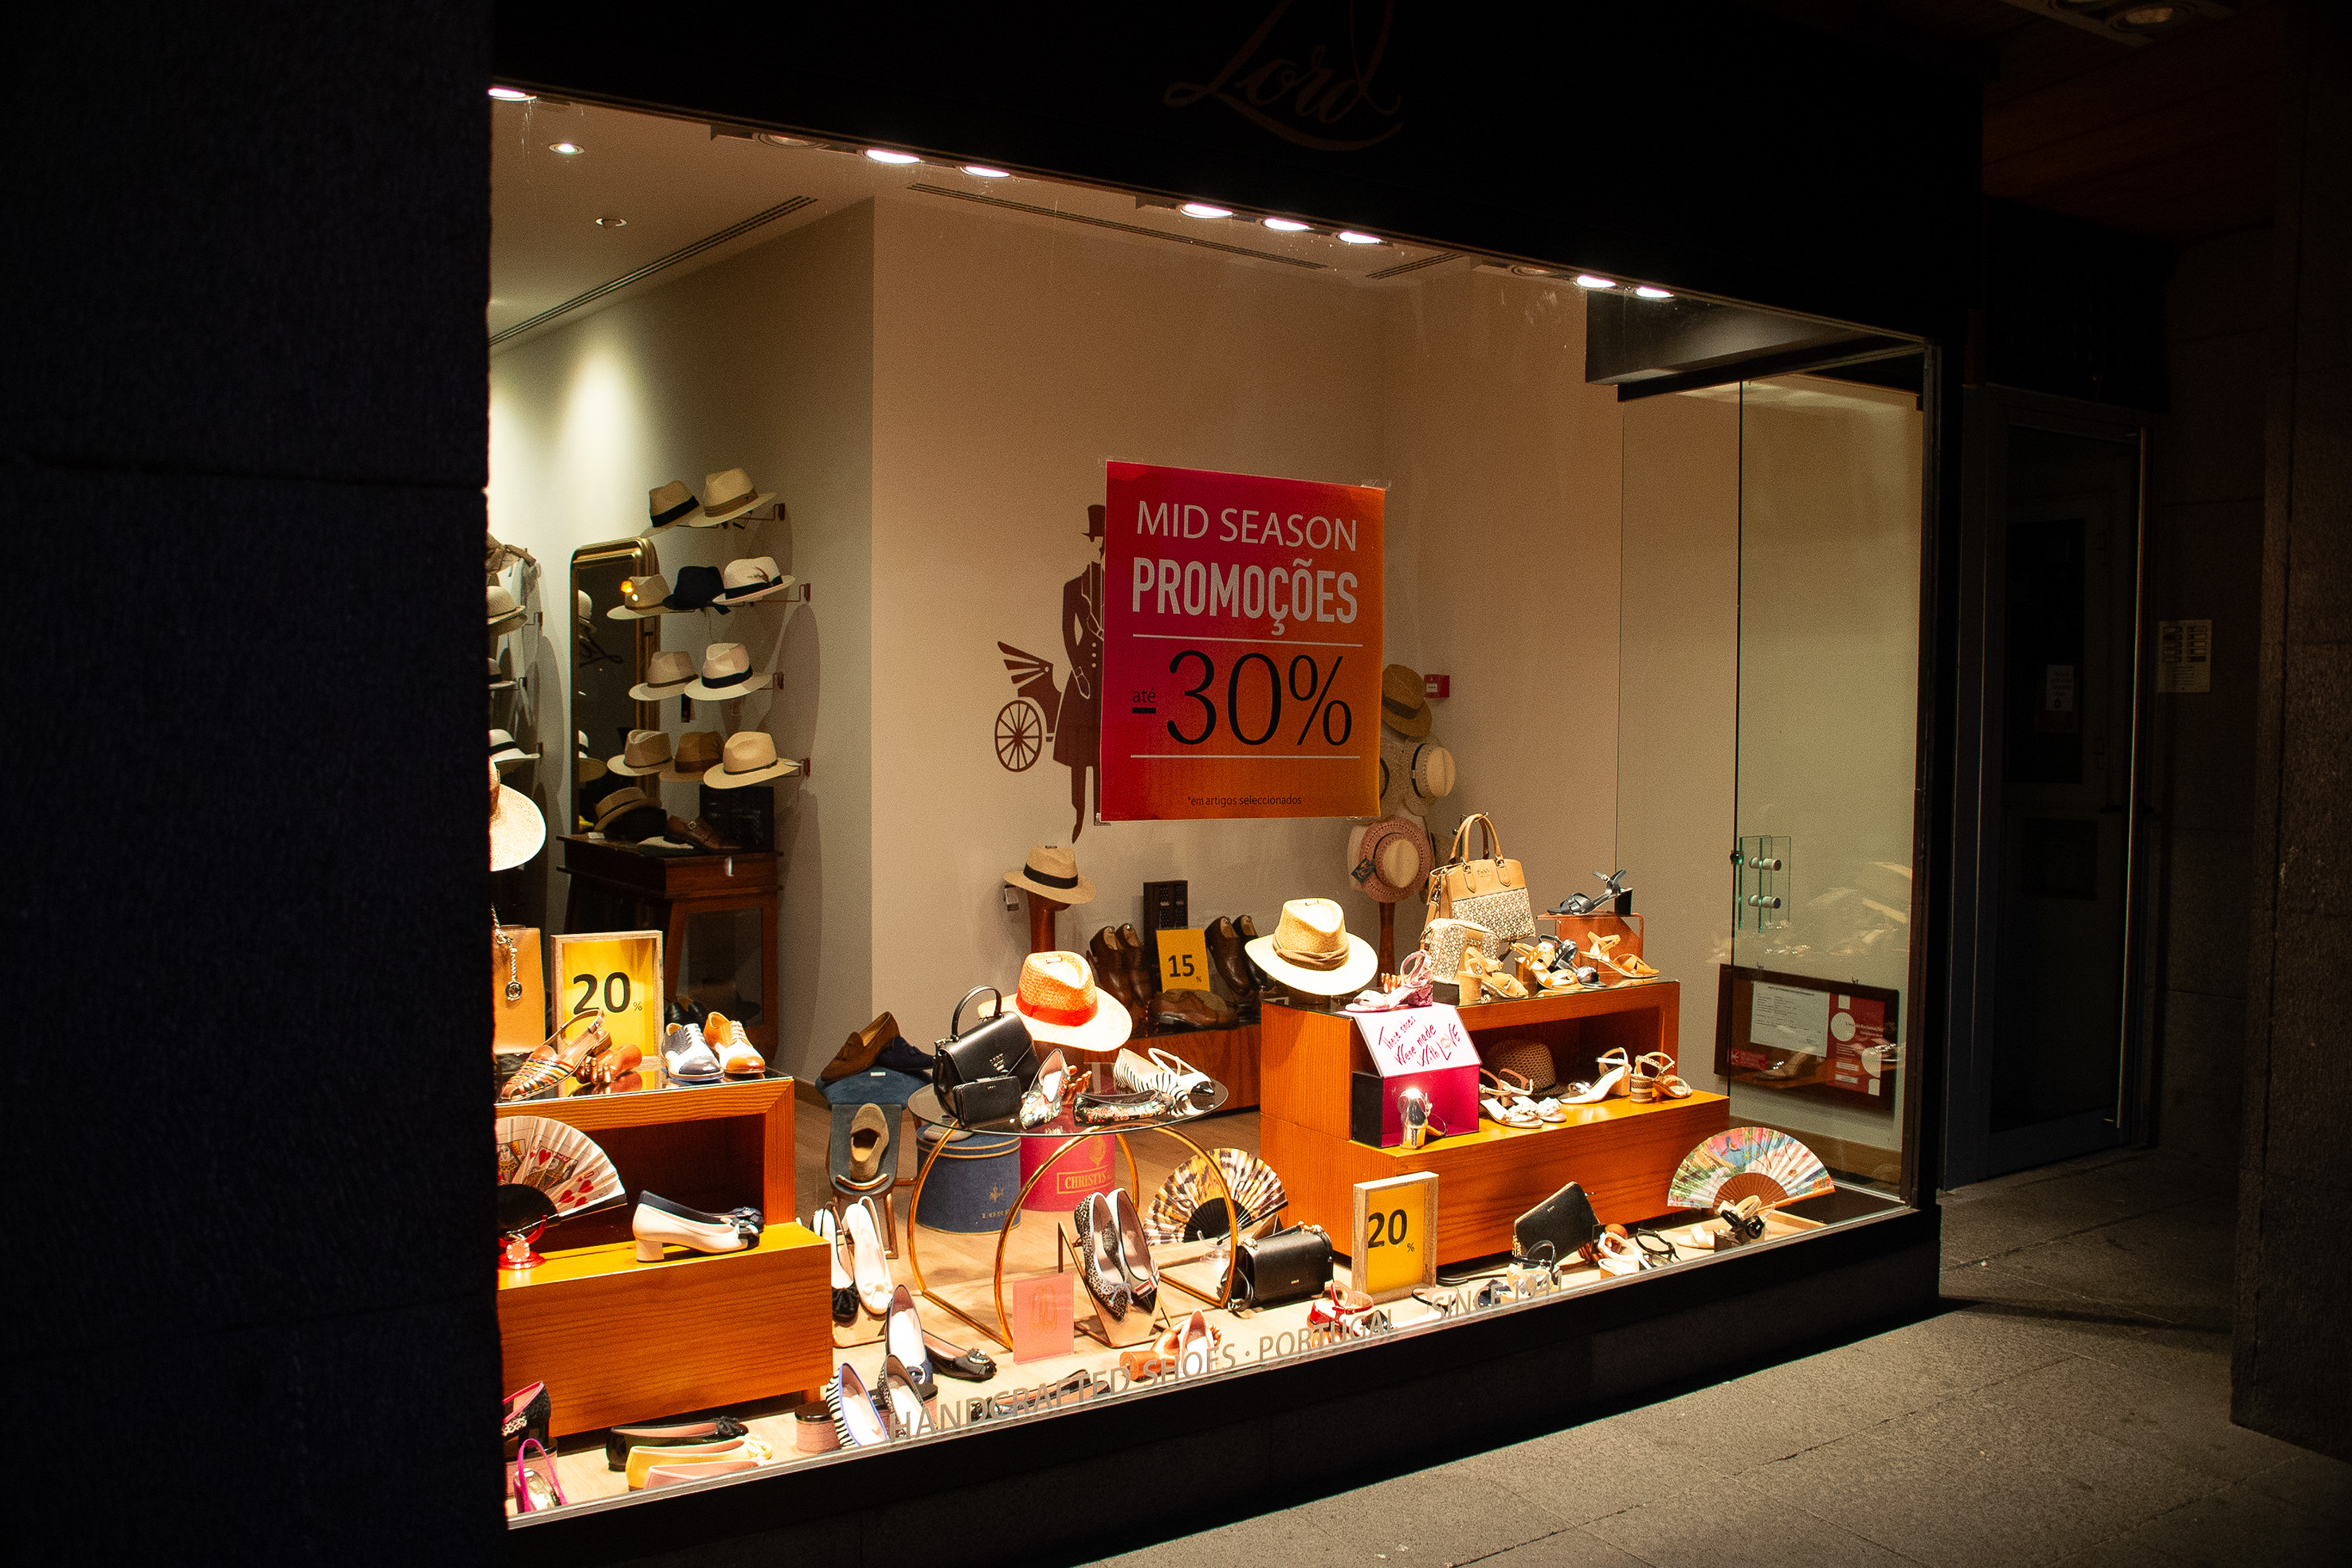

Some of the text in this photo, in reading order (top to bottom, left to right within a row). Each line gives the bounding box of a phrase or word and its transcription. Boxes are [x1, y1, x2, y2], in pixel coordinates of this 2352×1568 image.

[1163, 0, 1404, 151] Lord
[1136, 500, 1358, 551] MID SEASON
[1131, 556, 1358, 636] PROMOÇÕES
[1131, 687, 1157, 704] até
[1205, 795, 1237, 808] artigos
[1239, 794, 1303, 806] seleccionados
[1417, 1024, 1437, 1047] made
[890, 1367, 1131, 1441] HANDCRAFTED
[1143, 1343, 1237, 1388] SHOES
[1259, 1308, 1393, 1362] PORTUGAL
[1432, 1284, 1503, 1322] SINCE
